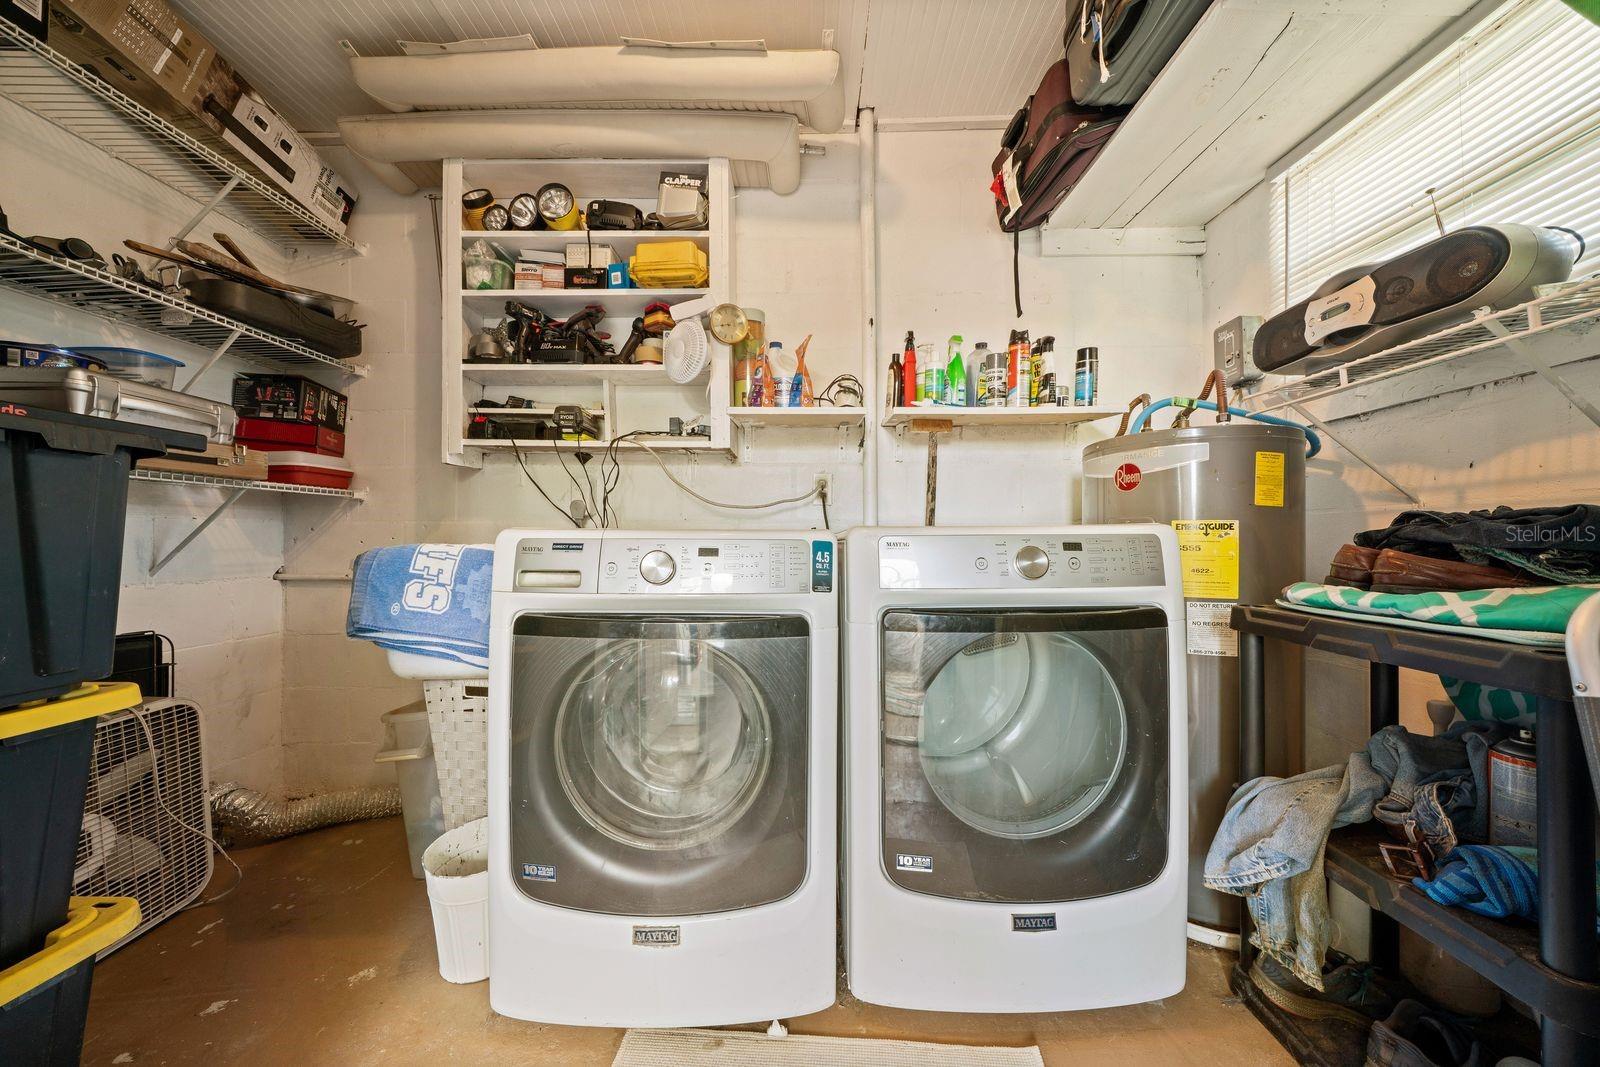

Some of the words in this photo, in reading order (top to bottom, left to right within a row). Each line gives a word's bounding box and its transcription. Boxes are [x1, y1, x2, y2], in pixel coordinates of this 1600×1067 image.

[664, 176, 701, 187] CLAPPER
[1116, 463, 1141, 488] Rheem
[816, 551, 830, 563] 4.5
[898, 855, 913, 866] 10
[523, 864, 538, 875] 10
[1015, 917, 1054, 928] MAYTAG
[636, 931, 676, 941] MAYTAG
